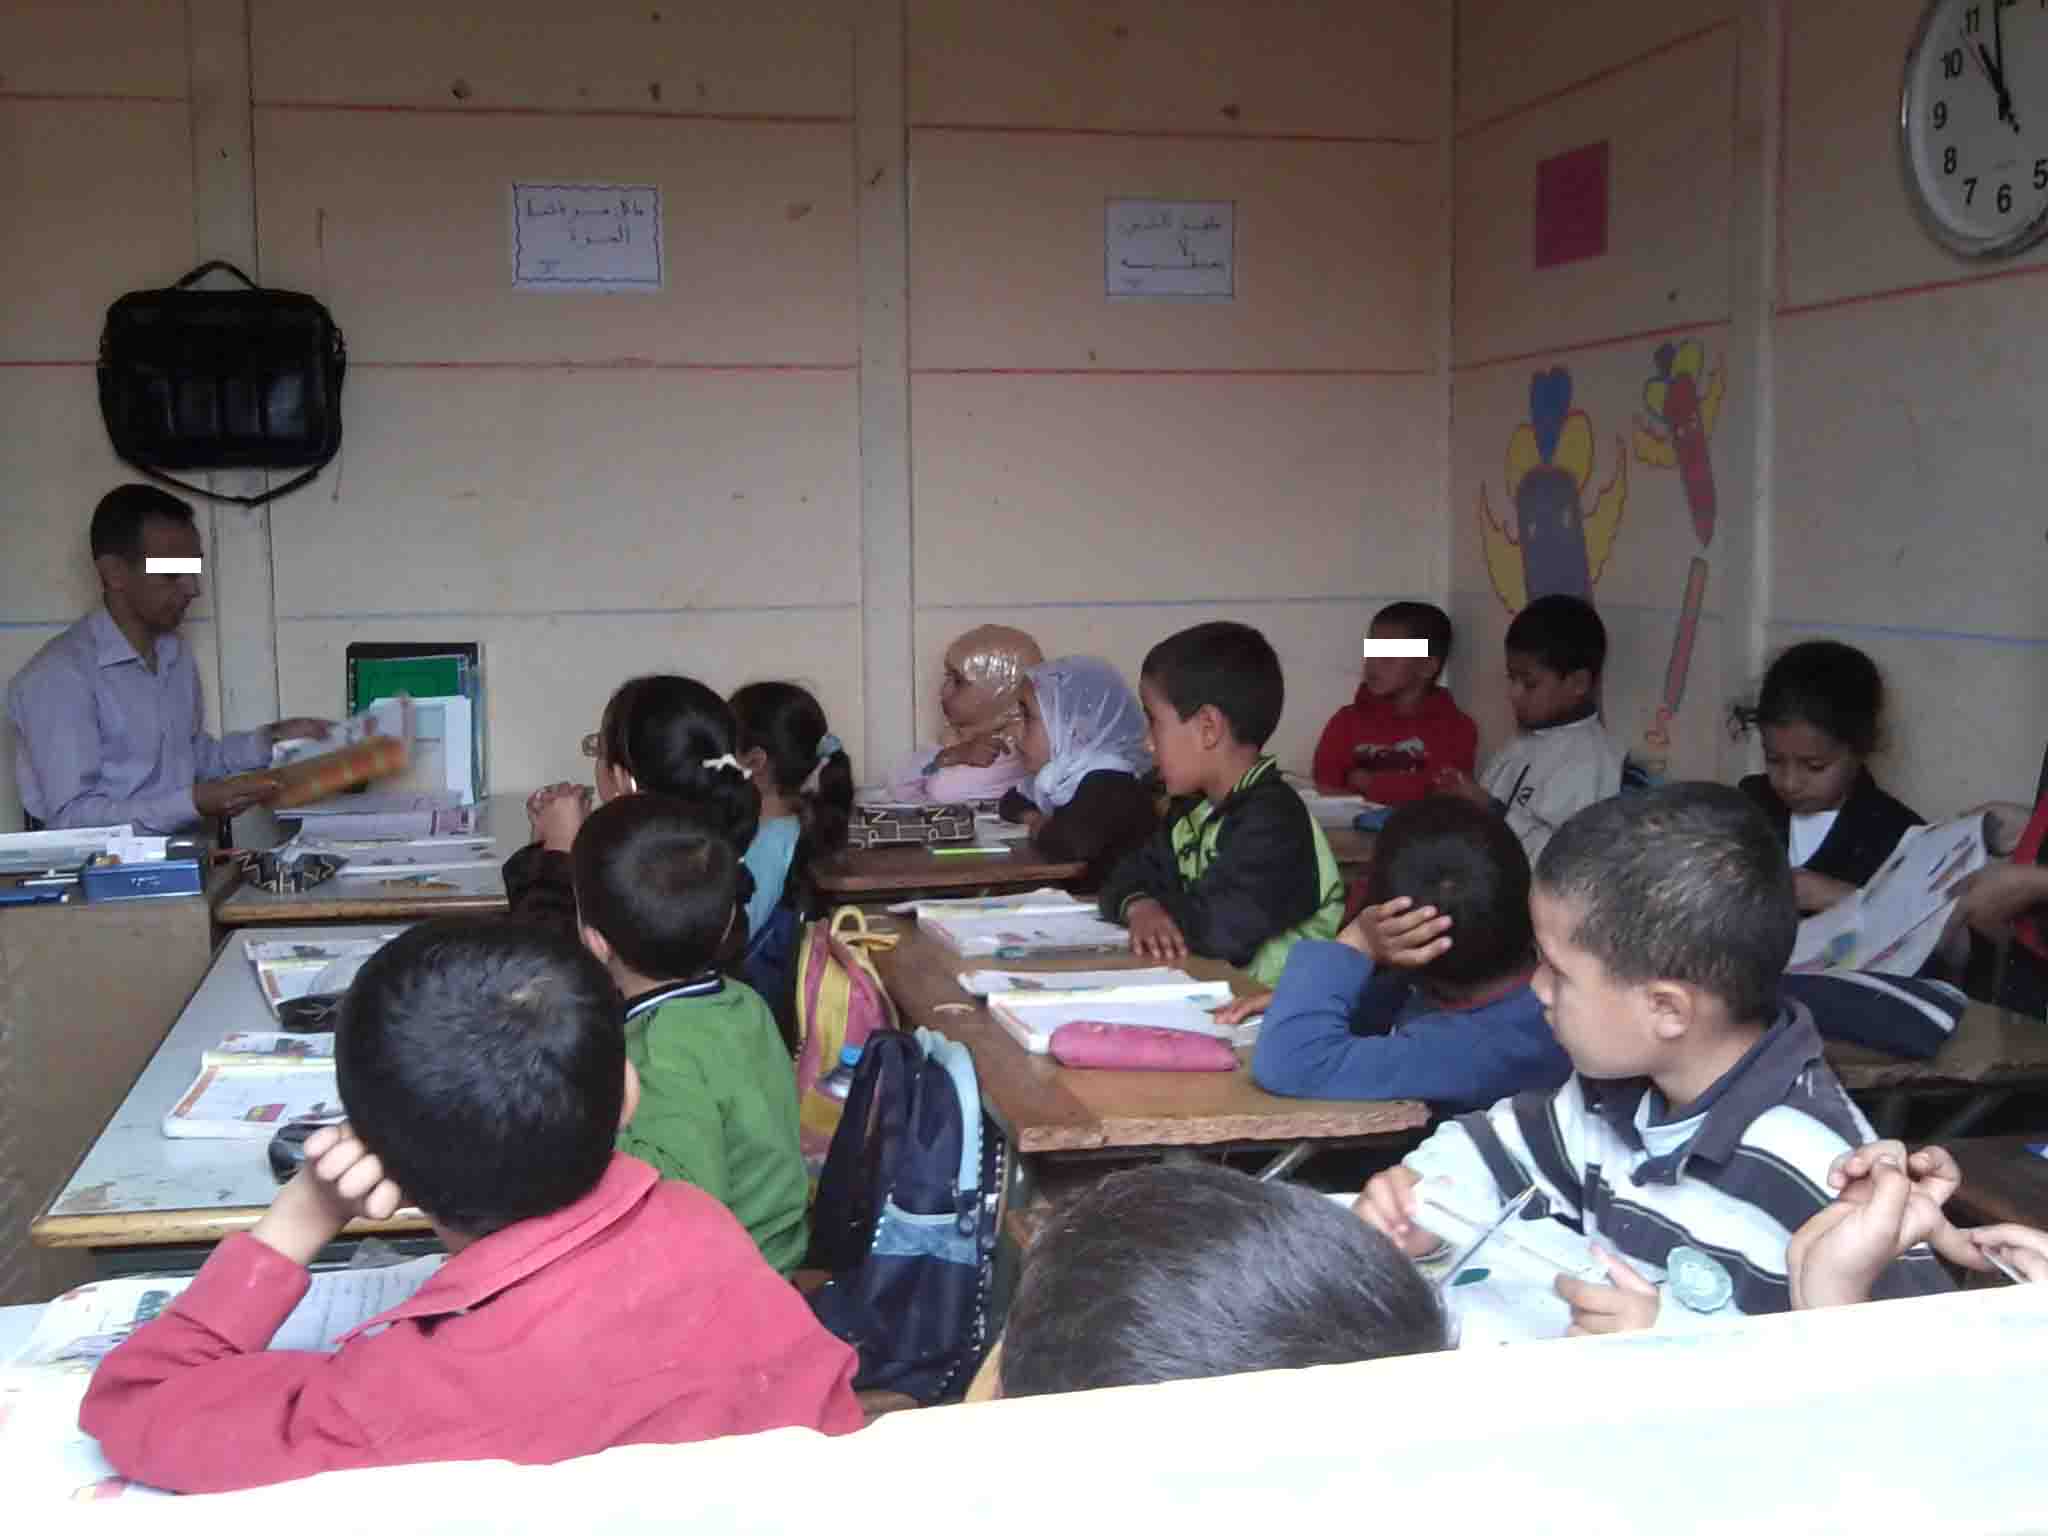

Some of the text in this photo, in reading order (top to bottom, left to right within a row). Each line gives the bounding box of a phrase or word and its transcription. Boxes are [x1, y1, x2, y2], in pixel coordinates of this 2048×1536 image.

[1940, 48, 1963, 80] 10
[1933, 100, 1948, 132] 9
[1943, 146, 1958, 175] 8
[2033, 158, 2048, 190] 5
[1962, 177, 1977, 206] 7
[1997, 183, 2012, 213] 6
